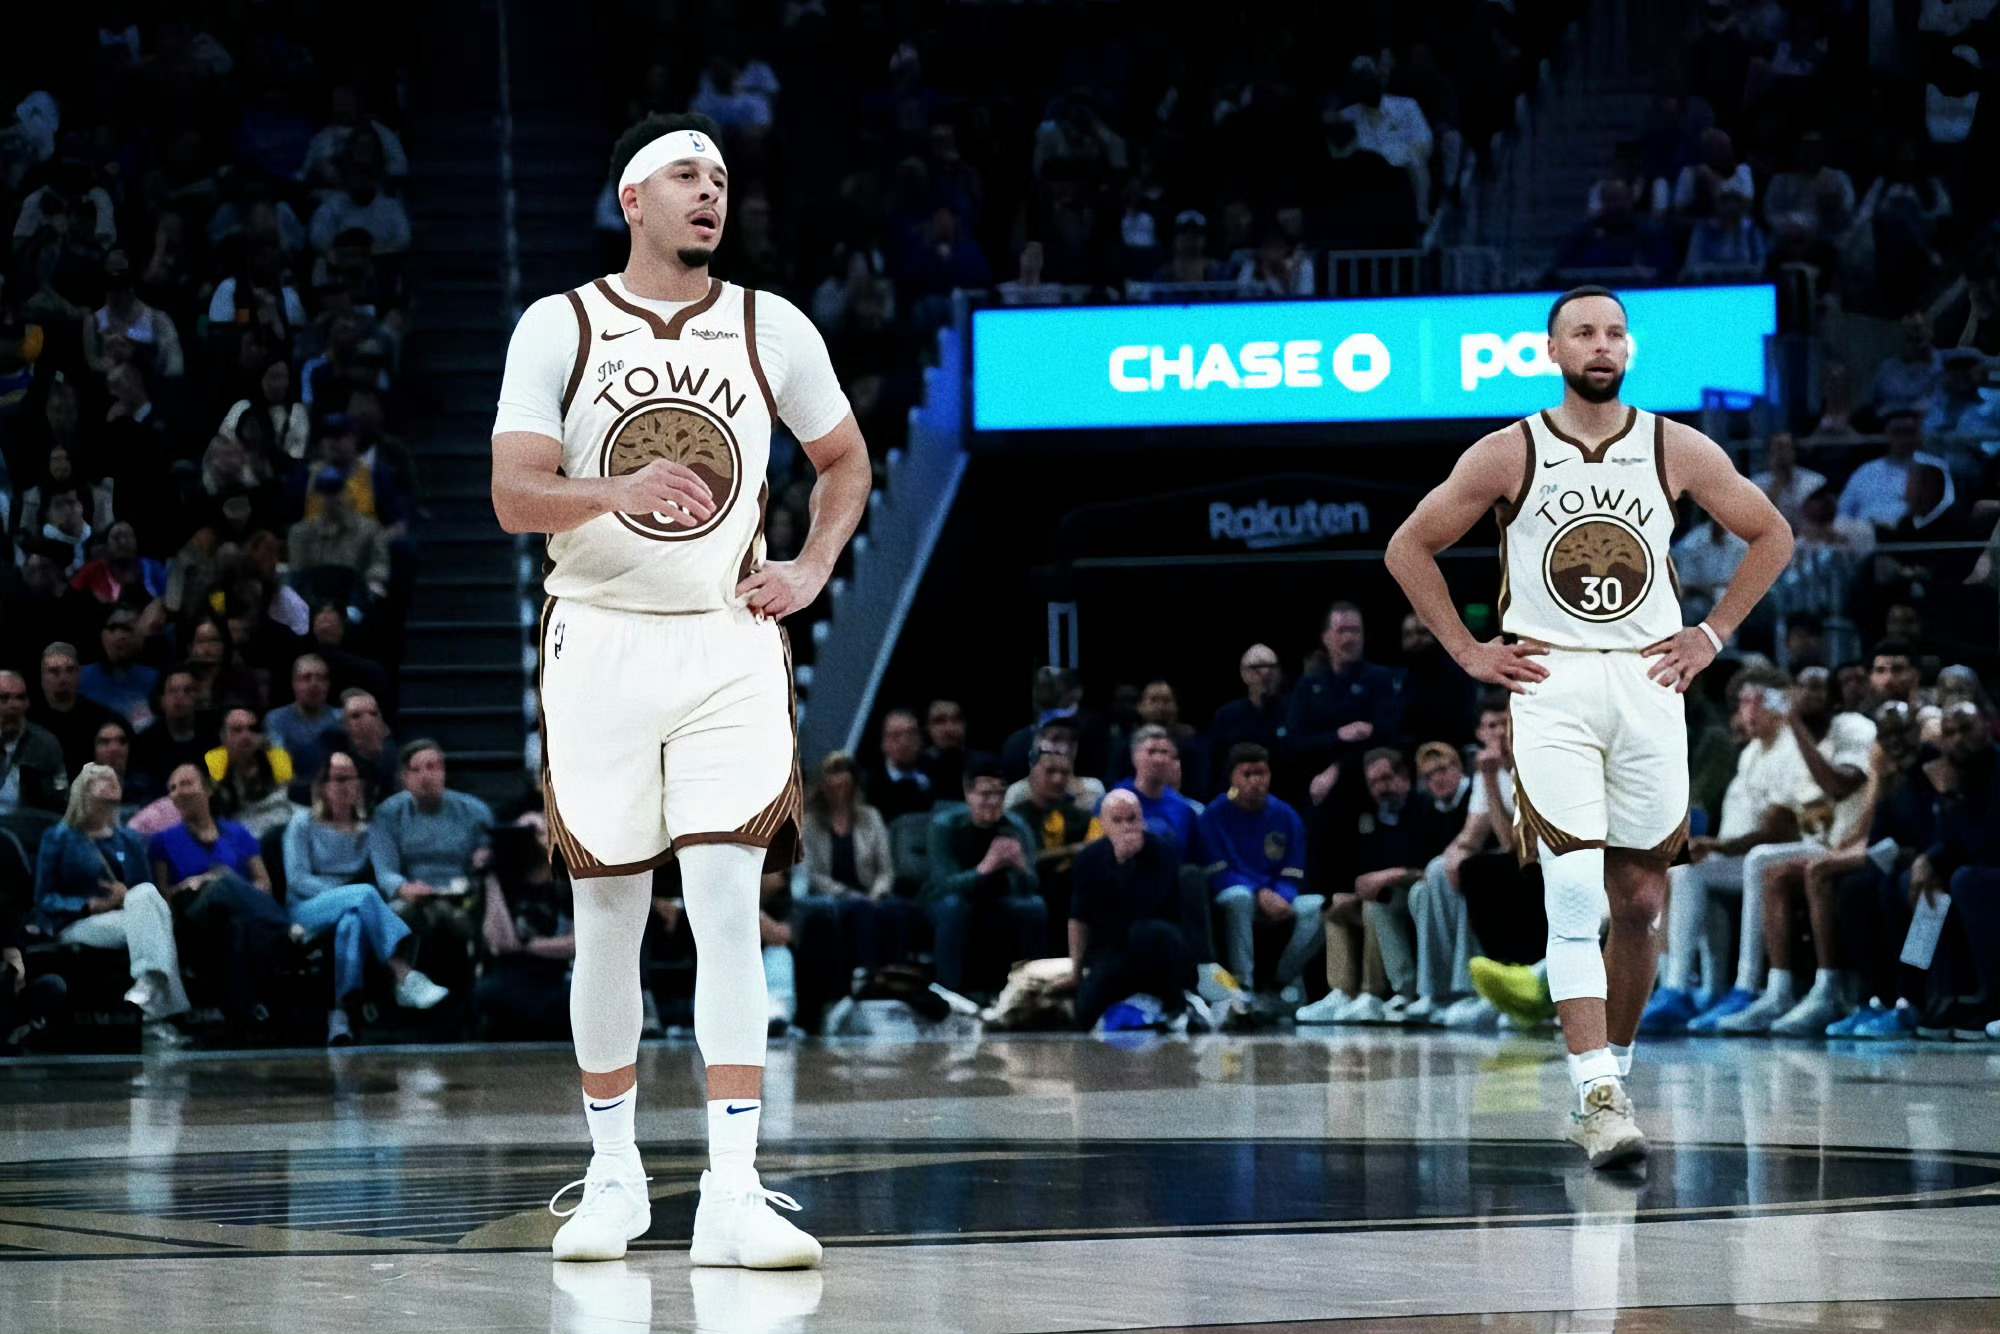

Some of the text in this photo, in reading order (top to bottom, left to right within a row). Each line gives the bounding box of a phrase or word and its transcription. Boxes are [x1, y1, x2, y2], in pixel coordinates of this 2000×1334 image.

[593, 360, 747, 419] TOWN
[1108, 339, 1323, 393] CHASE
[1208, 498, 1370, 548] Rakuten
[1534, 484, 1654, 527] TOWN
[1579, 576, 1623, 612] 30
